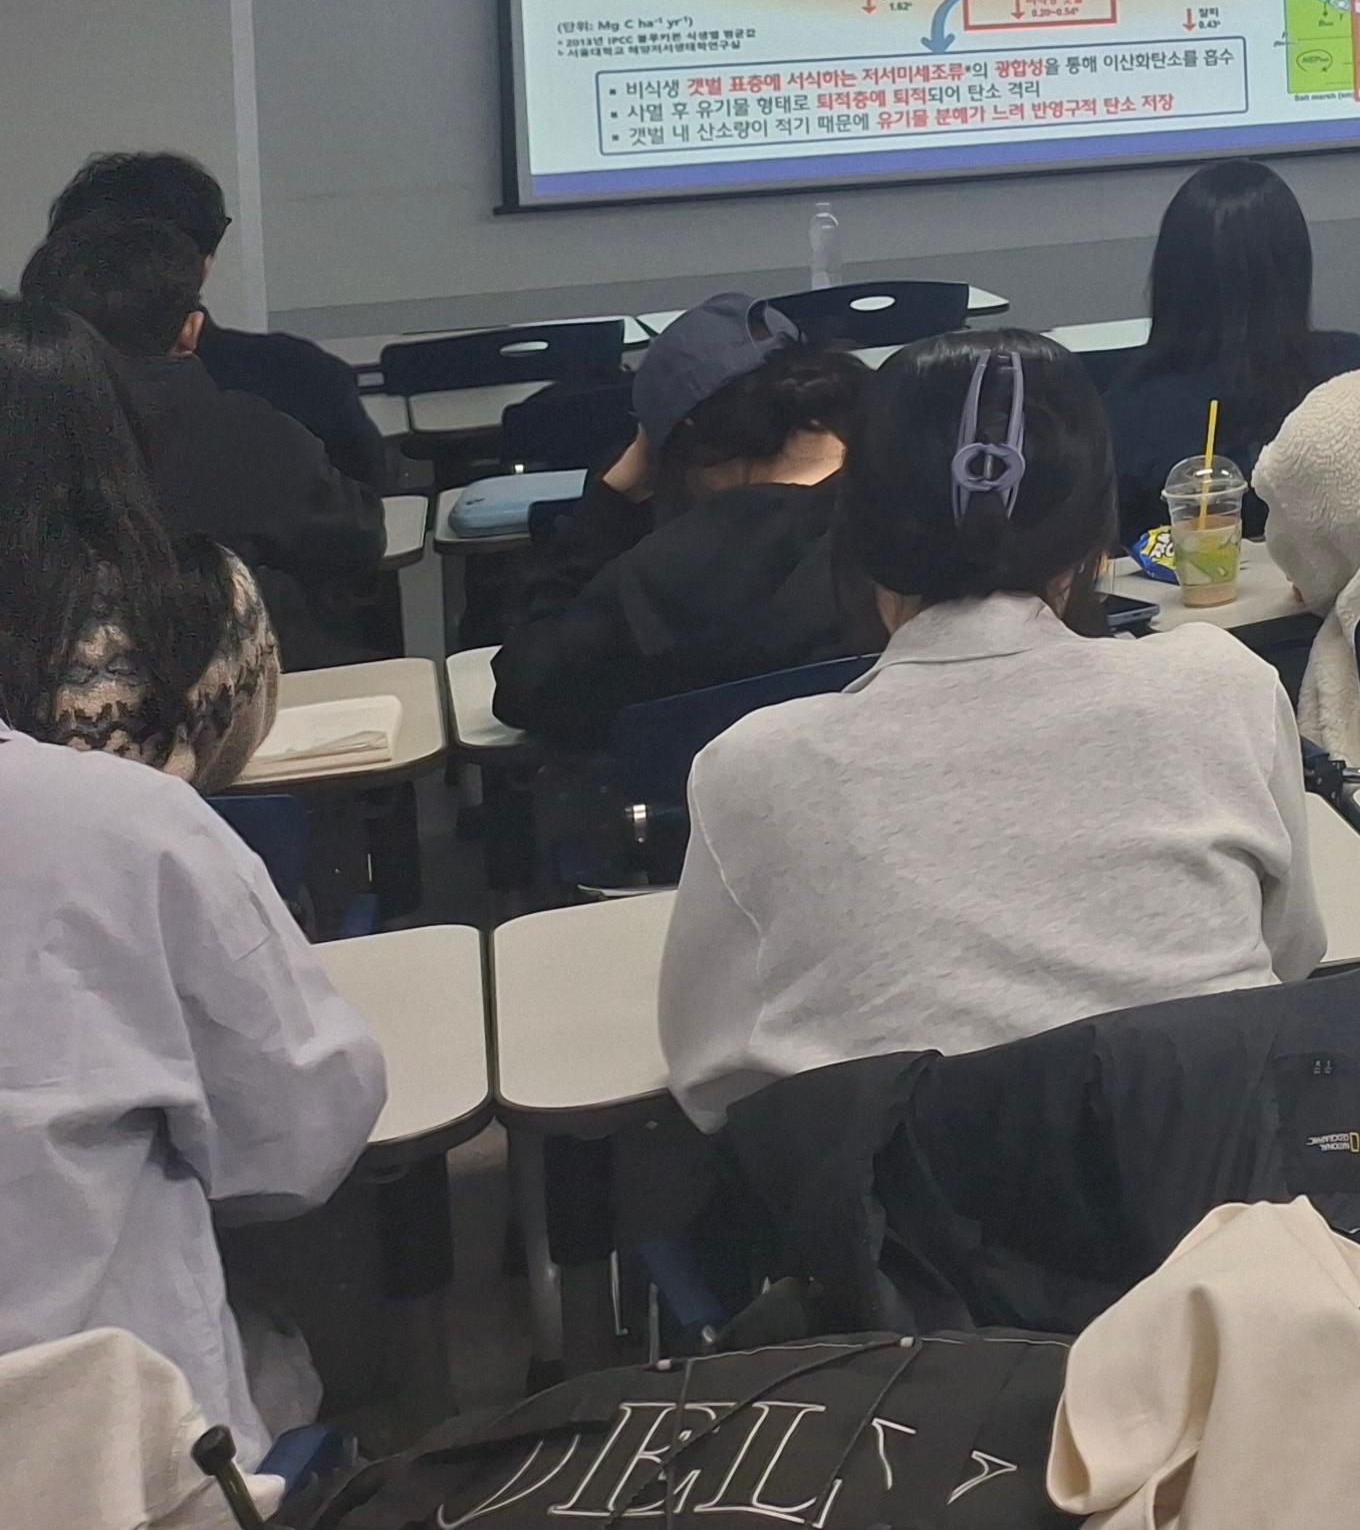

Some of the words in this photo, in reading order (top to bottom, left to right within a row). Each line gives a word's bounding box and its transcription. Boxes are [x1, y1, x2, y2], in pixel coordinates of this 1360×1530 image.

[557, 21, 593, 35] (단위:
[597, 20, 620, 33] Mg
[624, 19, 634, 30] C
[625, 80, 680, 99] 비식생
[688, 76, 723, 97] 갯벌
[728, 72, 781, 92] 표층에
[787, 68, 857, 91] 서식하는
[994, 58, 1060, 79] 광합성을
[1065, 55, 1098, 75] 통해
[1103, 49, 1199, 72] 이산화탄소를
[1202, 47, 1235, 67] 흡수
[627, 103, 664, 123] 사멸
[671, 102, 690, 121] 후
[695, 98, 750, 119] 유기물
[757, 94, 811, 116] 형태로
[816, 89, 887, 111] 퇴적층에
[893, 84, 961, 106] 퇴적되어
[967, 83, 1002, 102] 탄소
[1007, 80, 1041, 99] 격리
[629, 126, 665, 147] 갯벌
[672, 124, 690, 144] 내
[696, 119, 769, 141] 산소량이
[775, 116, 811, 136] 적기
[817, 112, 870, 133] 때문에
[876, 109, 929, 129] 유기물
[934, 106, 986, 127] 분해가
[991, 103, 1025, 122] 느려
[1031, 98, 1097, 119] 반영구적
[1103, 96, 1137, 115] 탄소
[1141, 92, 1175, 112] 저장
